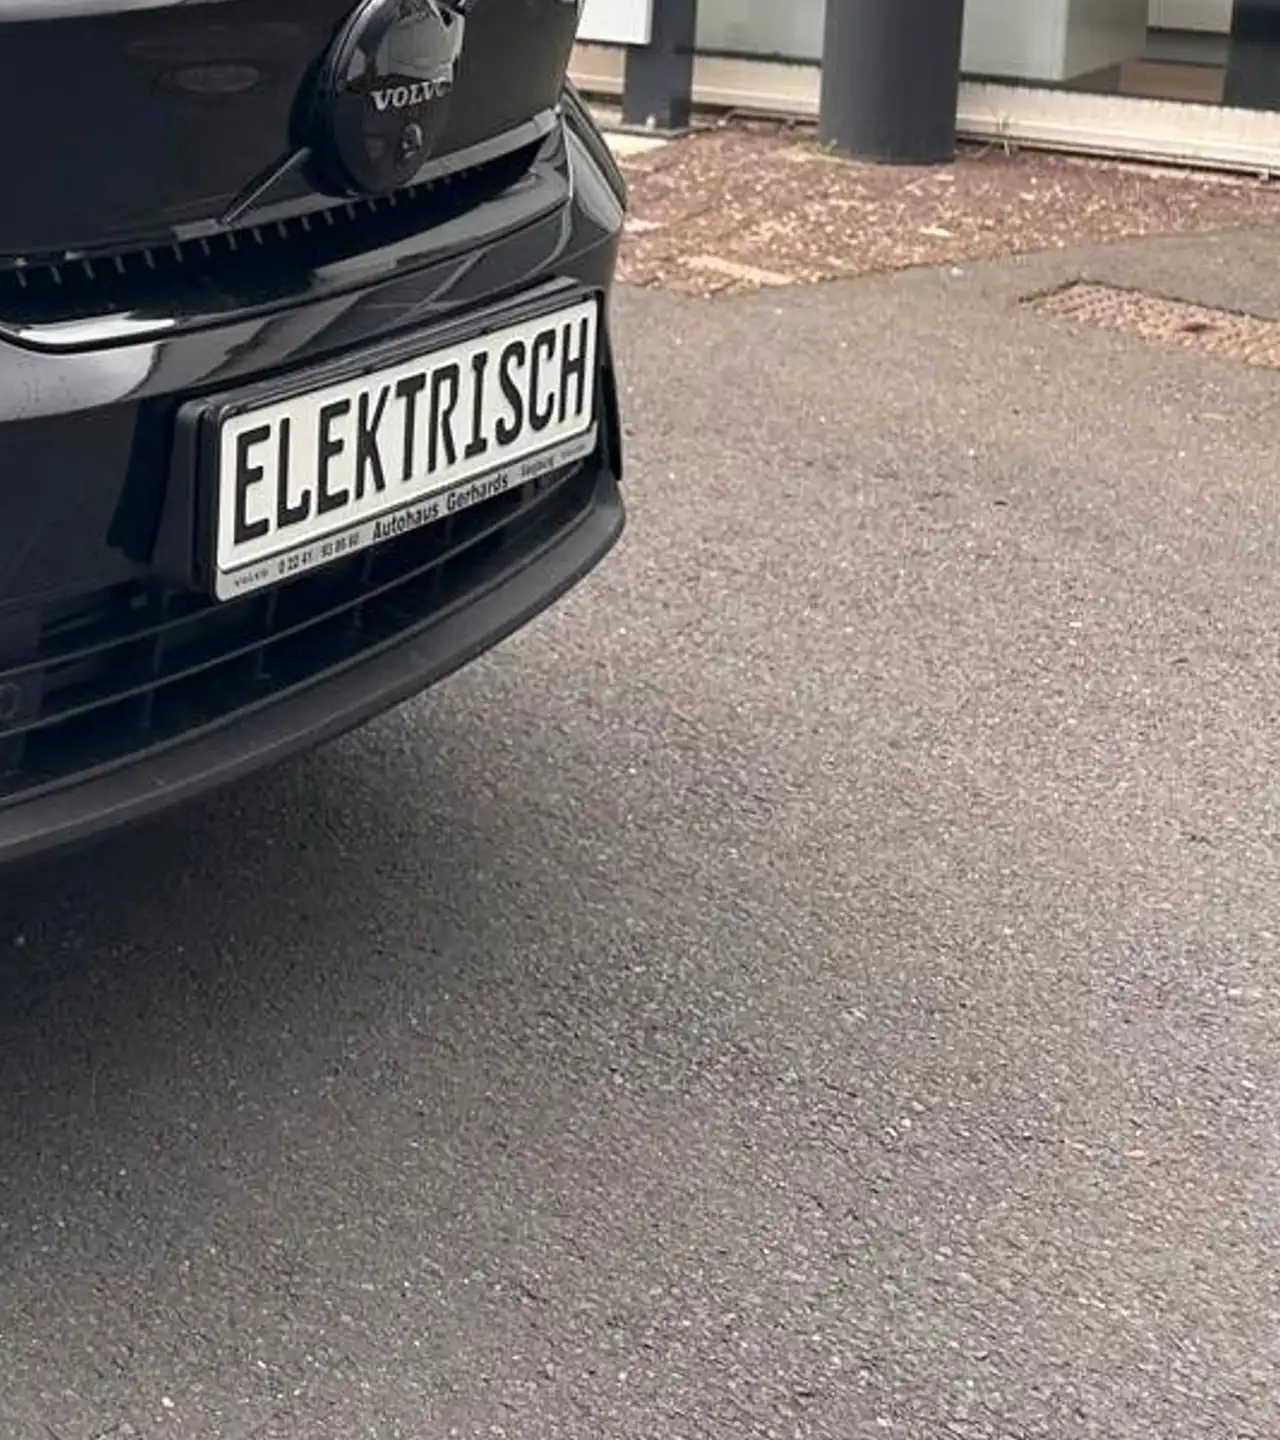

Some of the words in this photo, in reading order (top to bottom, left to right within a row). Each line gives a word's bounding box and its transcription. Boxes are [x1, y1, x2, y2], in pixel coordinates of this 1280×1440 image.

[233, 317, 590, 545] ELEKTRISCH
[372, 501, 439, 541] Autohaus
[446, 471, 509, 511] Gerhards
